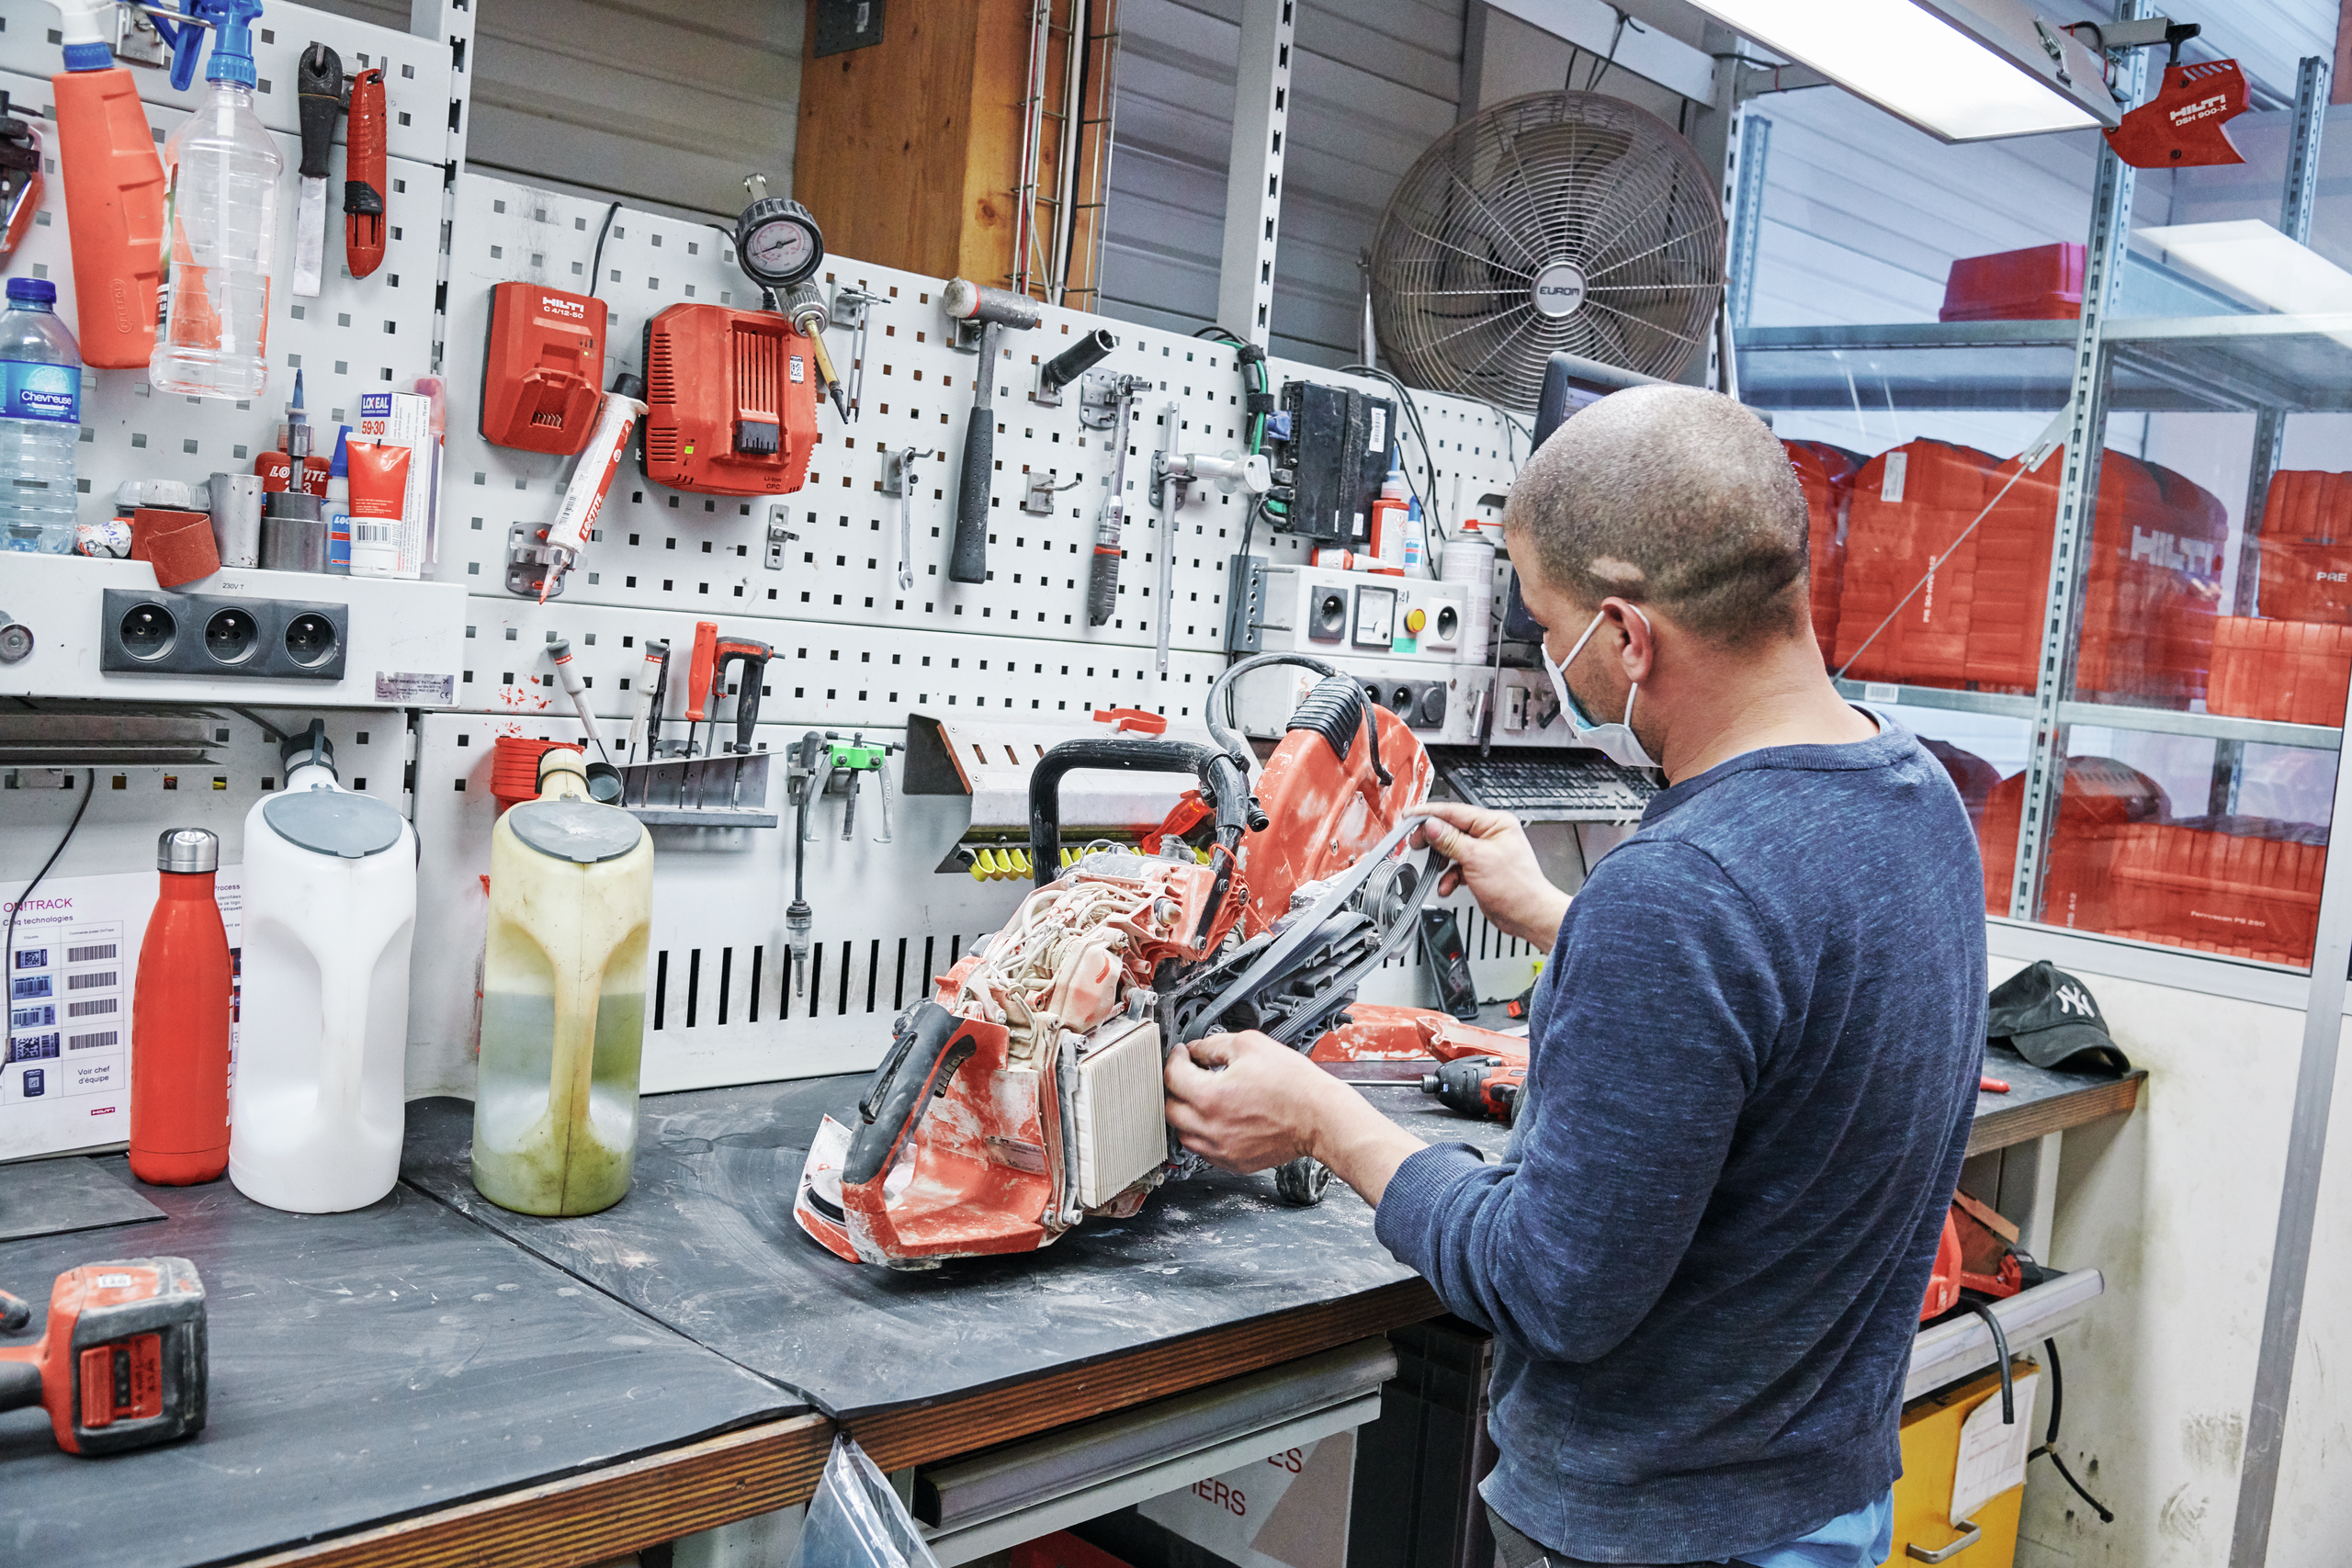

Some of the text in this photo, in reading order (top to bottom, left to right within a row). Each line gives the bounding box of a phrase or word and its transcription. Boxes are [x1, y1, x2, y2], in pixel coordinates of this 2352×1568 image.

[2169, 94, 2226, 120] HILTI
[2176, 104, 2227, 127] DSH 900-X
[1540, 286, 1580, 297] EUROM
[542, 296, 584, 313] HILTI
[551, 308, 584, 320] 4/12-50
[21, 390, 73, 405] Chevreuse
[361, 420, 386, 435] 59-30
[582, 492, 604, 538] LOCTITE
[2131, 525, 2213, 576] HILTI
[3, 915, 74, 927] Cnq technologies
[2055, 984, 2096, 1019] NY
[94, 1066, 110, 1075] chef
[78, 1075, 109, 1085] d'équipe
